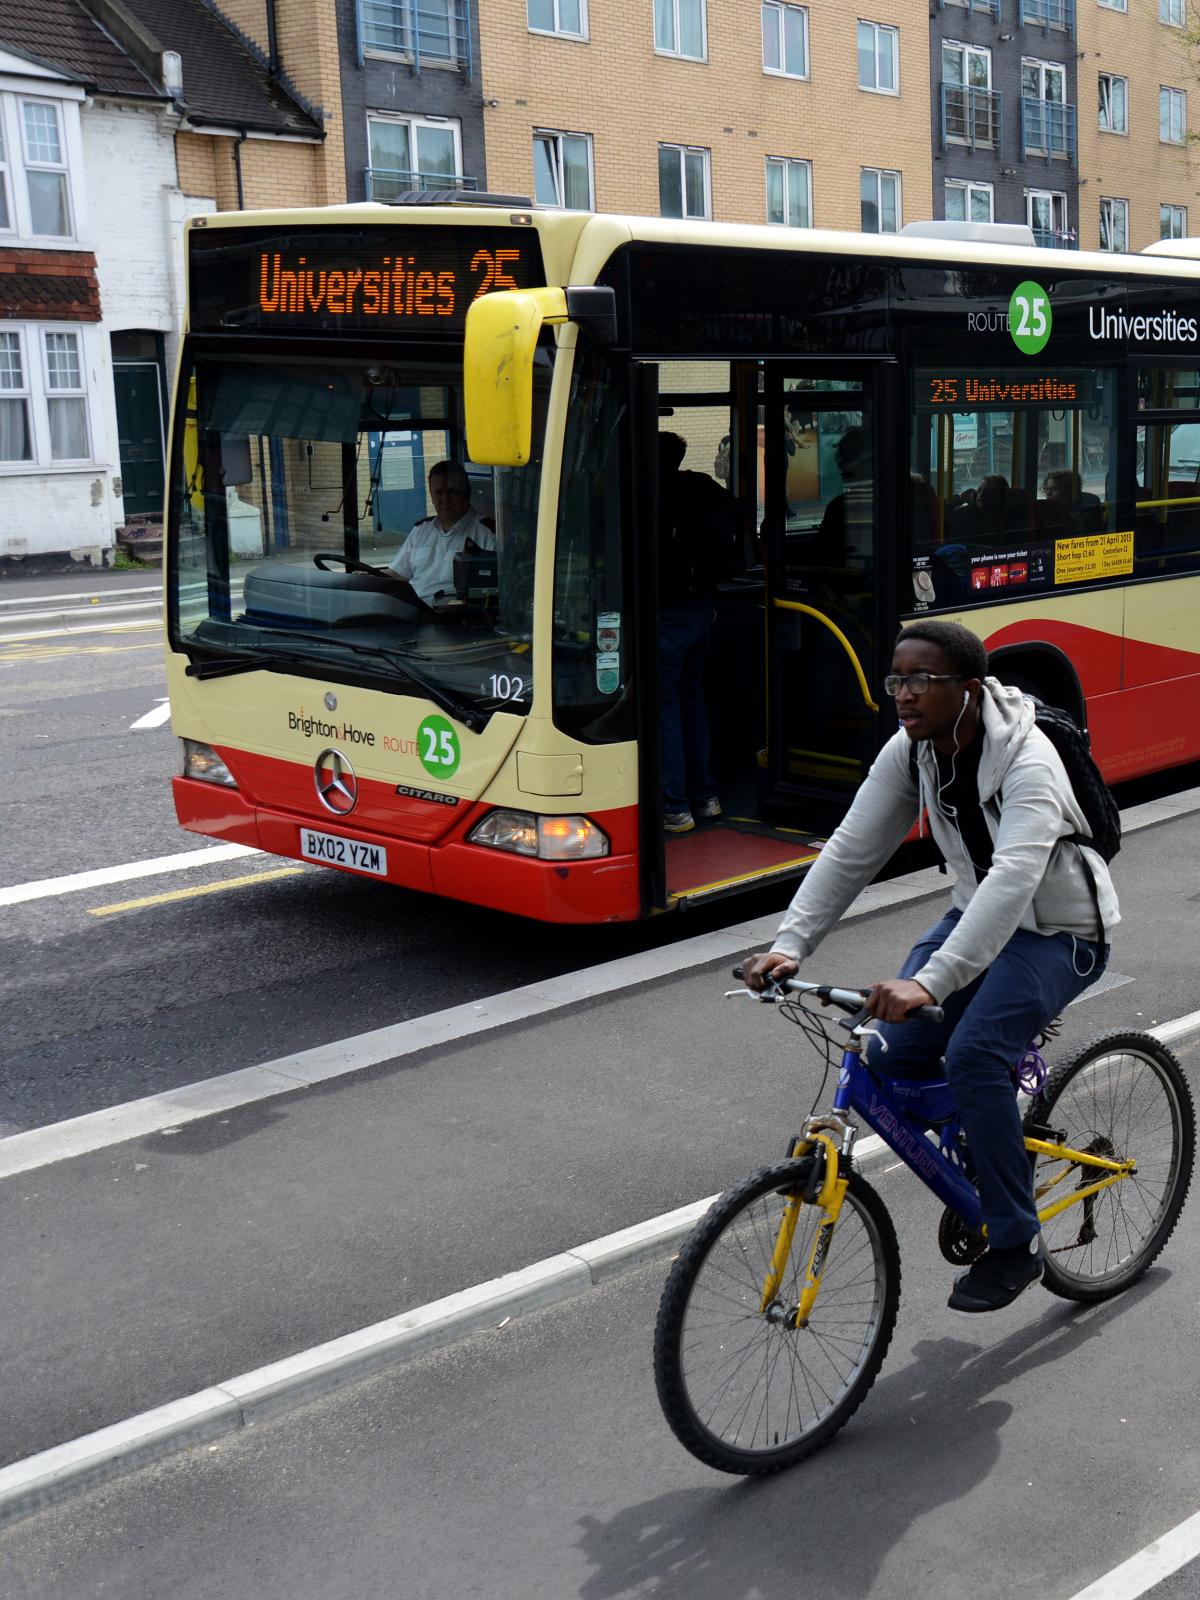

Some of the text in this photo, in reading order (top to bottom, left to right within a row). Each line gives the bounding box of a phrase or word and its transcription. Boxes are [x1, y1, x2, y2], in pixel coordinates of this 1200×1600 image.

[260, 249, 520, 315] Universities 25
[968, 297, 1047, 338] ROUTE 25
[1089, 306, 1198, 342] Universities
[930, 378, 1077, 403] 25 Universities
[971, 557, 980, 565] your
[980, 554, 994, 562] phone
[1057, 542, 1070, 551] New
[1071, 540, 1085, 549] fares
[1085, 538, 1099, 547] from
[1100, 537, 1106, 545] 21
[1106, 535, 1120, 548] April
[1057, 553, 1071, 562] Short
[1072, 552, 1081, 560] hop
[489, 674, 524, 702] 102
[384, 726, 455, 766] ROUTE 25
[398, 786, 457, 805] CITARO
[307, 833, 380, 871] BX02 YZM
[868, 1094, 940, 1180] VENTURE
[810, 1226, 833, 1278] ZOOM
